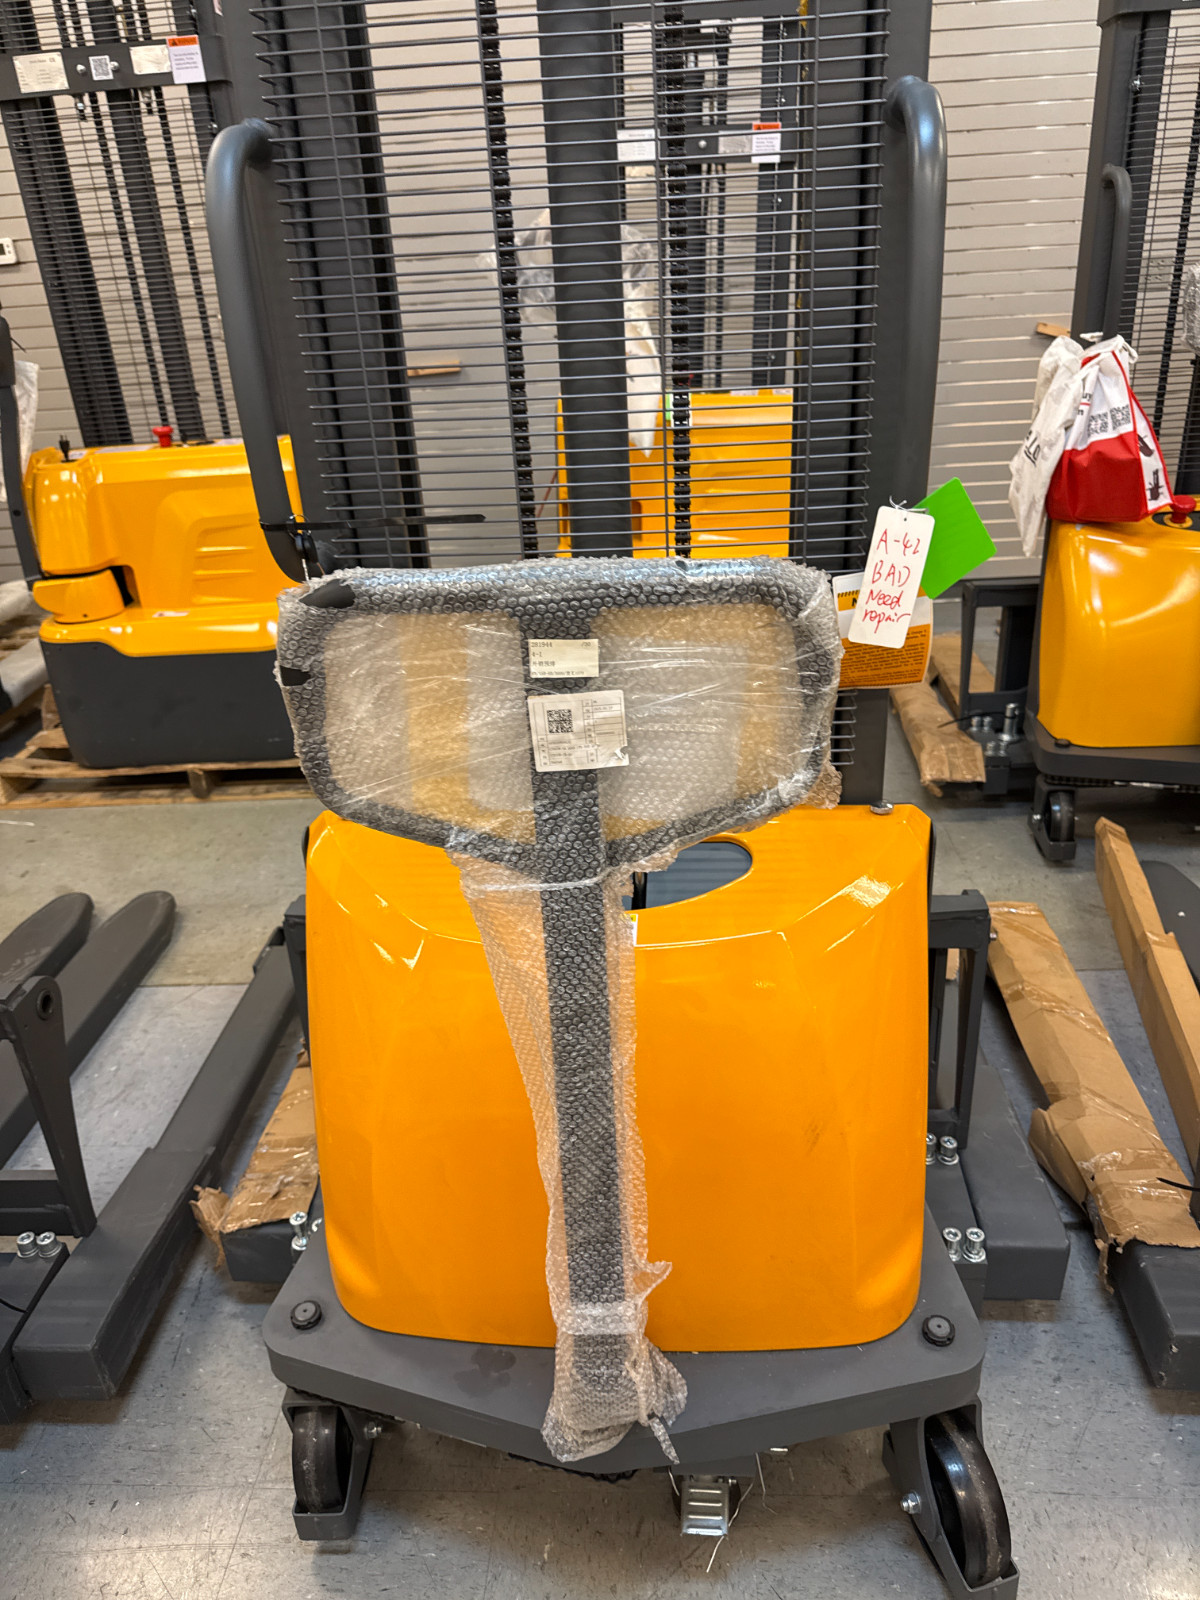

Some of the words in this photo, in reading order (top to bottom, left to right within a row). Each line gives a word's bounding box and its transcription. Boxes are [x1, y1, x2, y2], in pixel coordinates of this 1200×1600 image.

[876, 528, 922, 557] A-42
[871, 559, 912, 588] BAD
[865, 589, 904, 610] Need
[861, 609, 911, 634] repair
